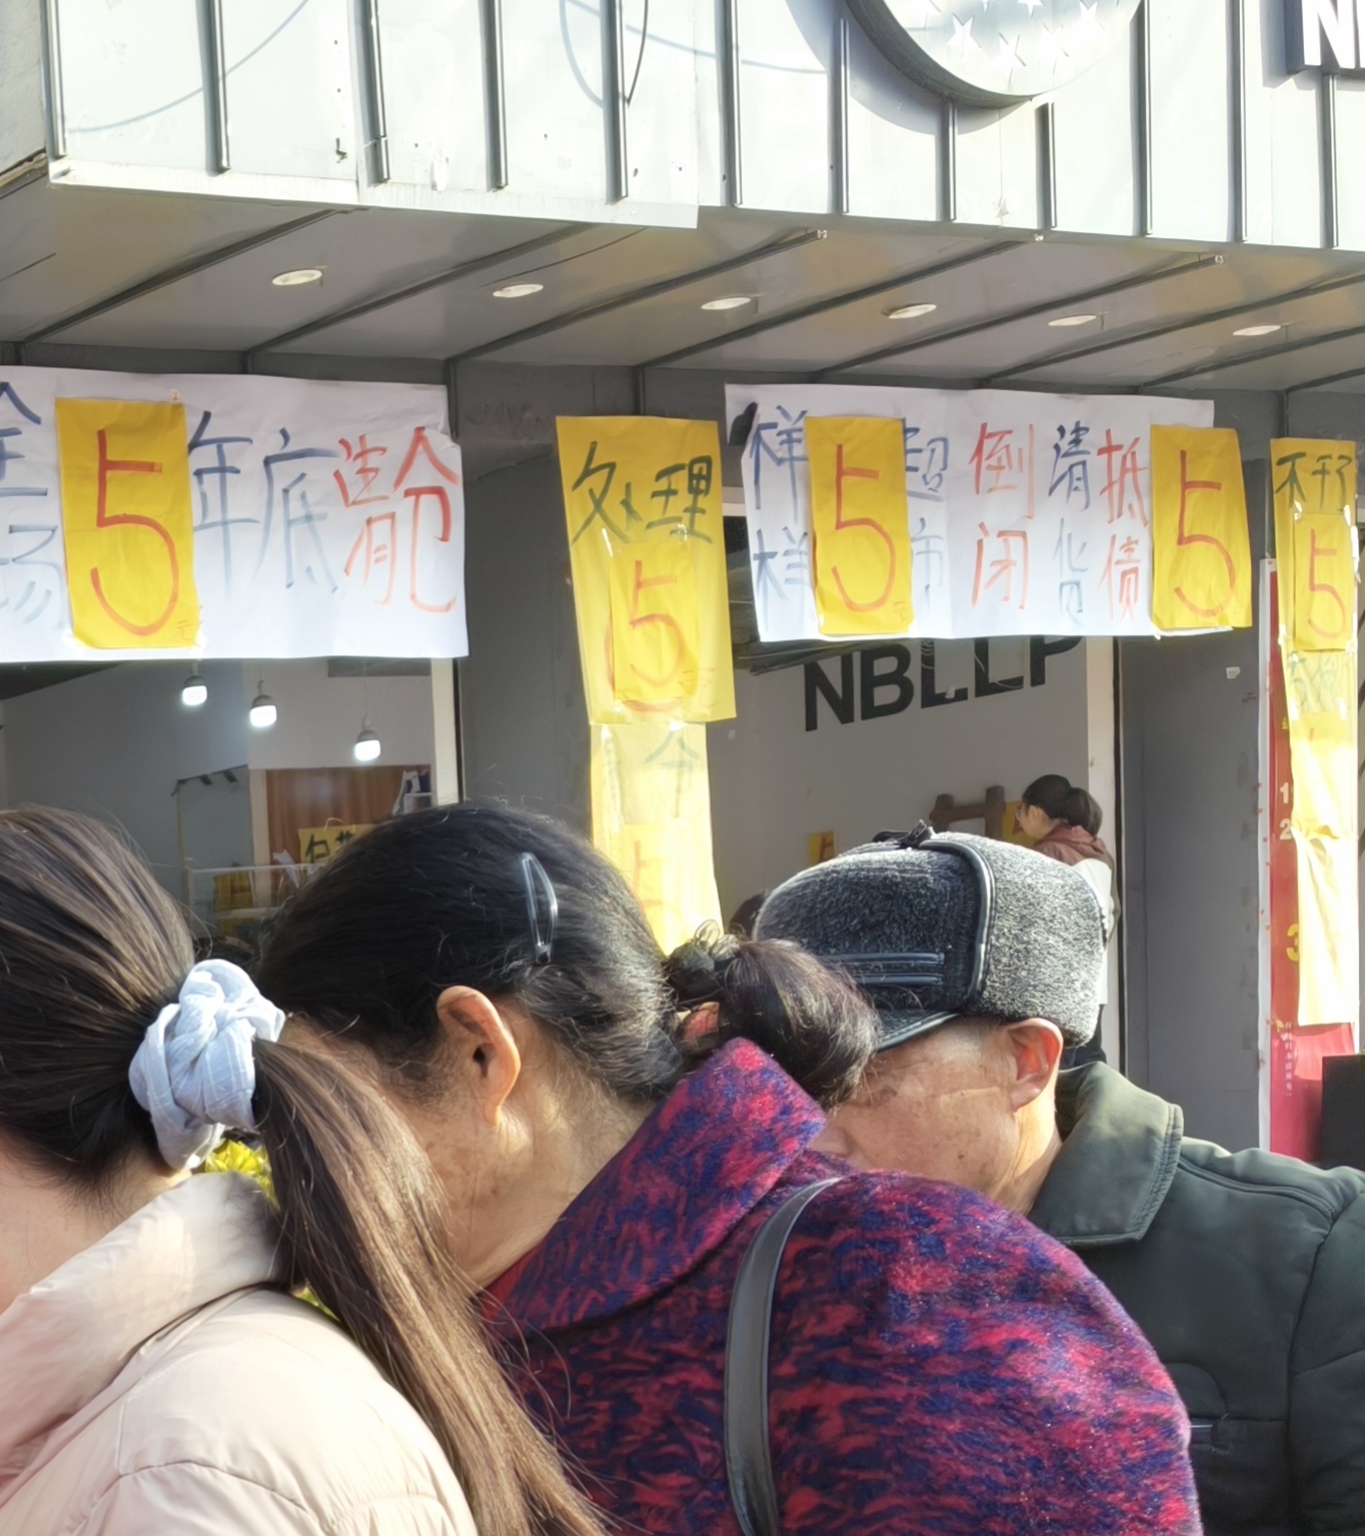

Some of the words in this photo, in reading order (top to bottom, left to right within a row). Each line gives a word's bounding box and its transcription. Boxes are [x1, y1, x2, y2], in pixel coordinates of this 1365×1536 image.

[91, 429, 180, 637] 5
[186, 410, 339, 600] 年底
[571, 440, 714, 545] 处理
[831, 443, 896, 611] 5
[969, 421, 1035, 612] 倒闭
[1173, 449, 1236, 618] 5
[629, 560, 687, 688] 5
[1307, 527, 1347, 640] 5
